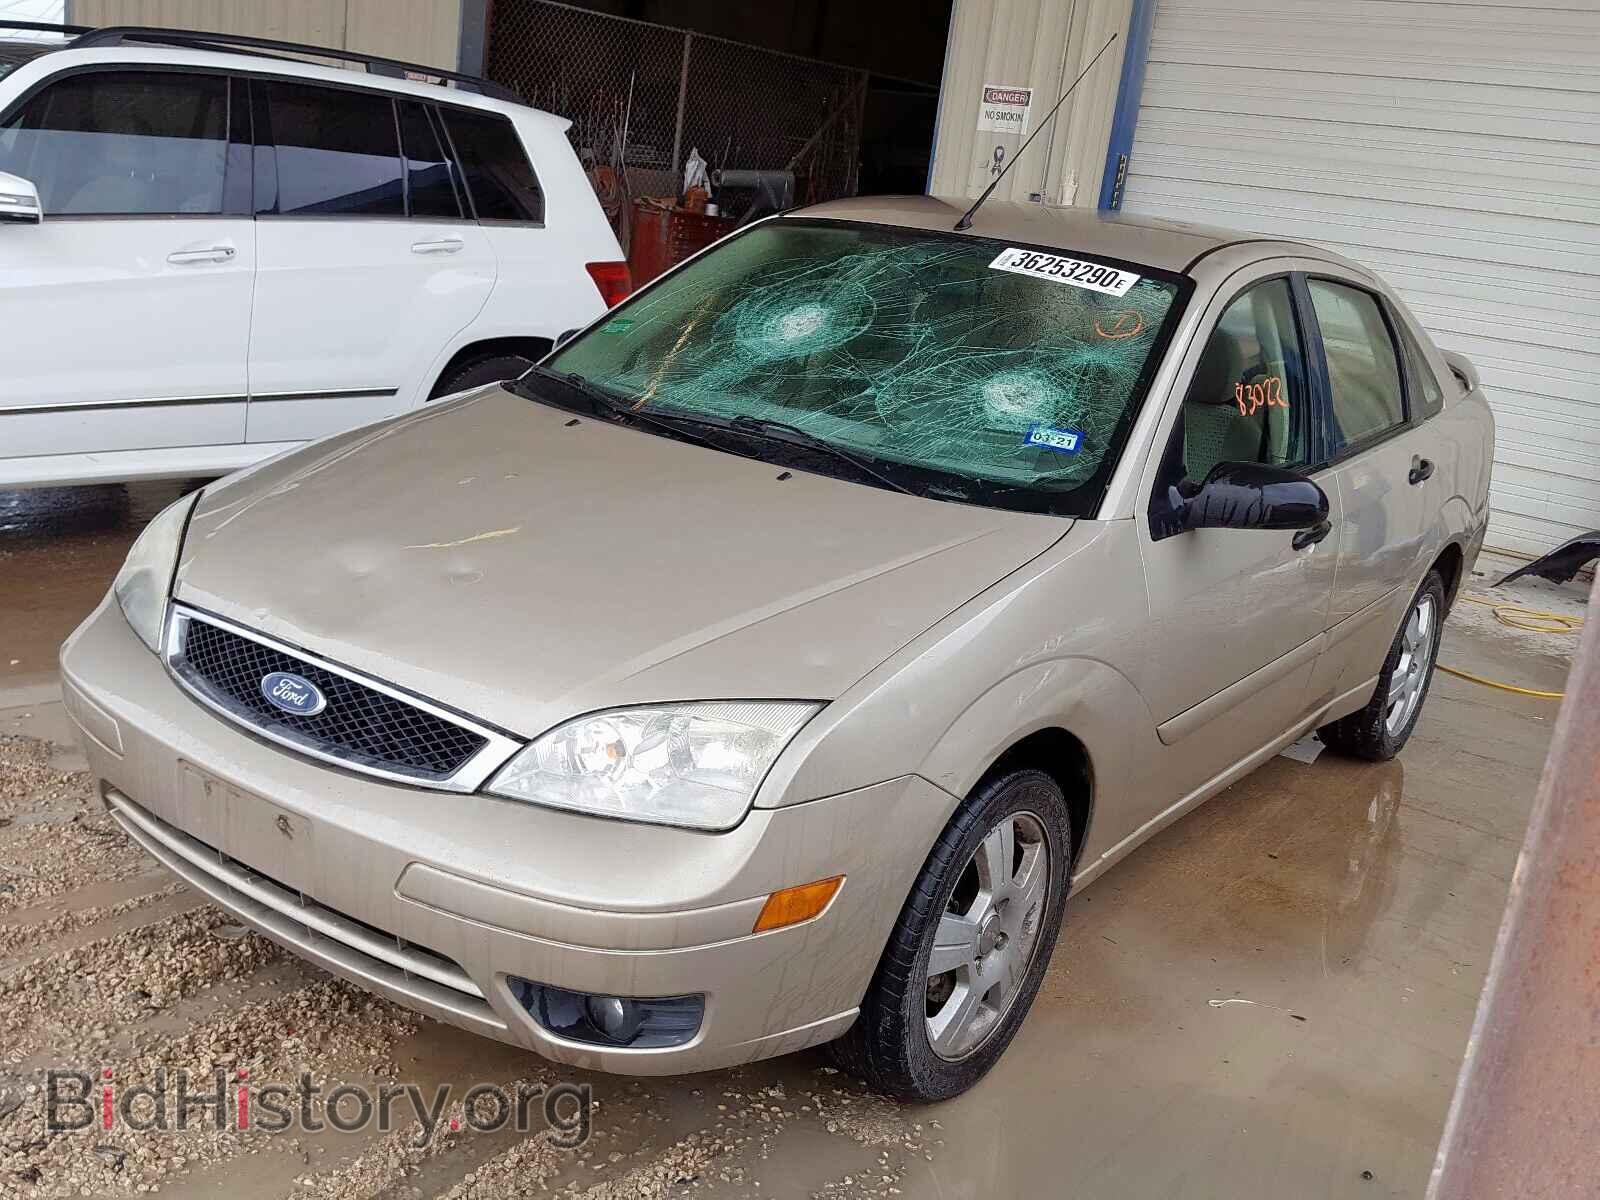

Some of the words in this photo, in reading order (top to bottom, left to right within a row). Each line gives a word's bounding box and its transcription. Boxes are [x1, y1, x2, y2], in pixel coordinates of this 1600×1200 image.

[992, 91, 1025, 103] DANGER
[985, 110, 995, 120] NO
[1011, 252, 1119, 288] 36253290
[1235, 377, 1289, 416] 83022
[273, 678, 309, 706] Ford
